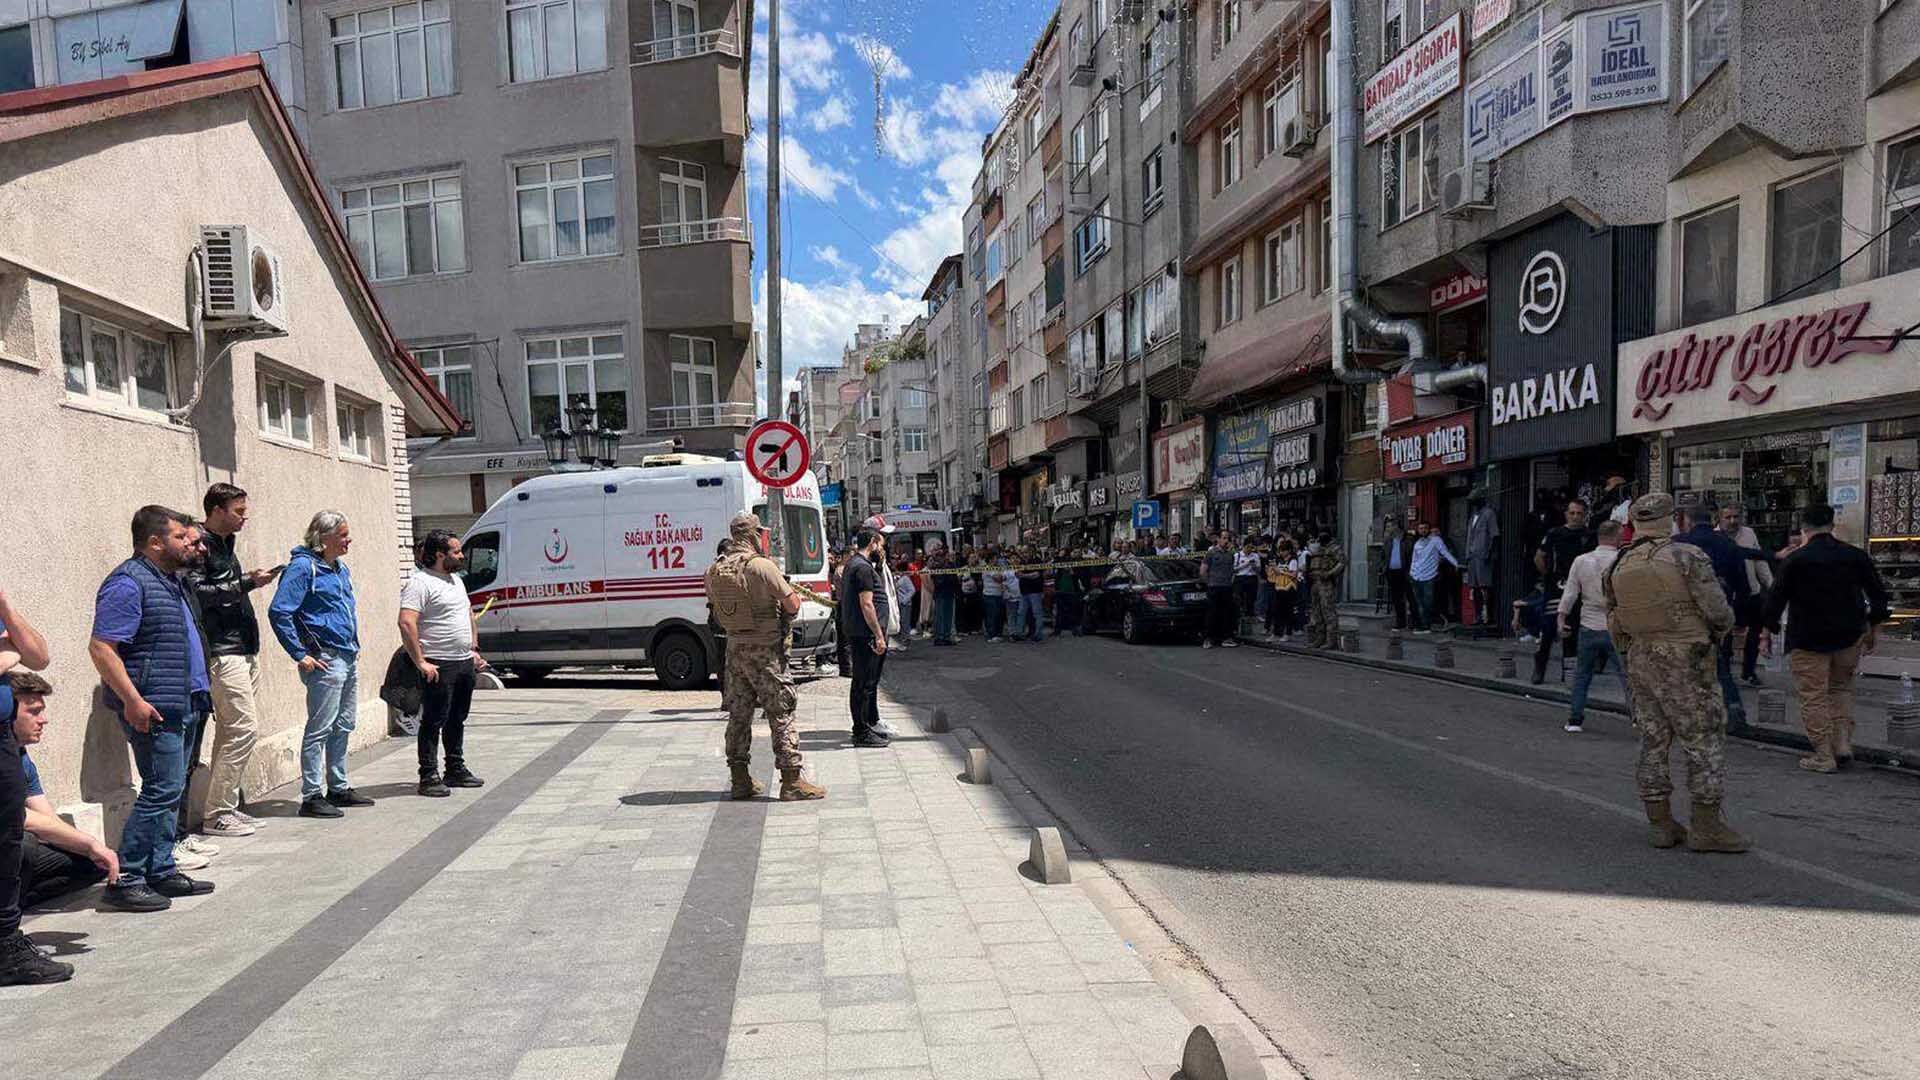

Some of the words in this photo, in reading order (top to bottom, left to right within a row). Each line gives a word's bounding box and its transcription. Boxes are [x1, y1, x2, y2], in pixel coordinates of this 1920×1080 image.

[1366, 58, 1413, 113] BATURALP
[1413, 24, 1458, 77] SİGORTA
[1602, 46, 1650, 73] İDEAL
[1431, 275, 1488, 305] DÖN
[1491, 363, 1600, 426] BARAKA
[1390, 435, 1423, 466] DİYAR
[1426, 424, 1466, 458] DÖNER
[487, 458, 505, 469] EFE
[655, 513, 672, 529] T.C.
[1138, 504, 1153, 527] P
[624, 529, 653, 547] SAĞLIK
[656, 524, 703, 545] BAKANLIĞI
[647, 546, 685, 570] 112
[515, 581, 592, 600] AMBULANS
